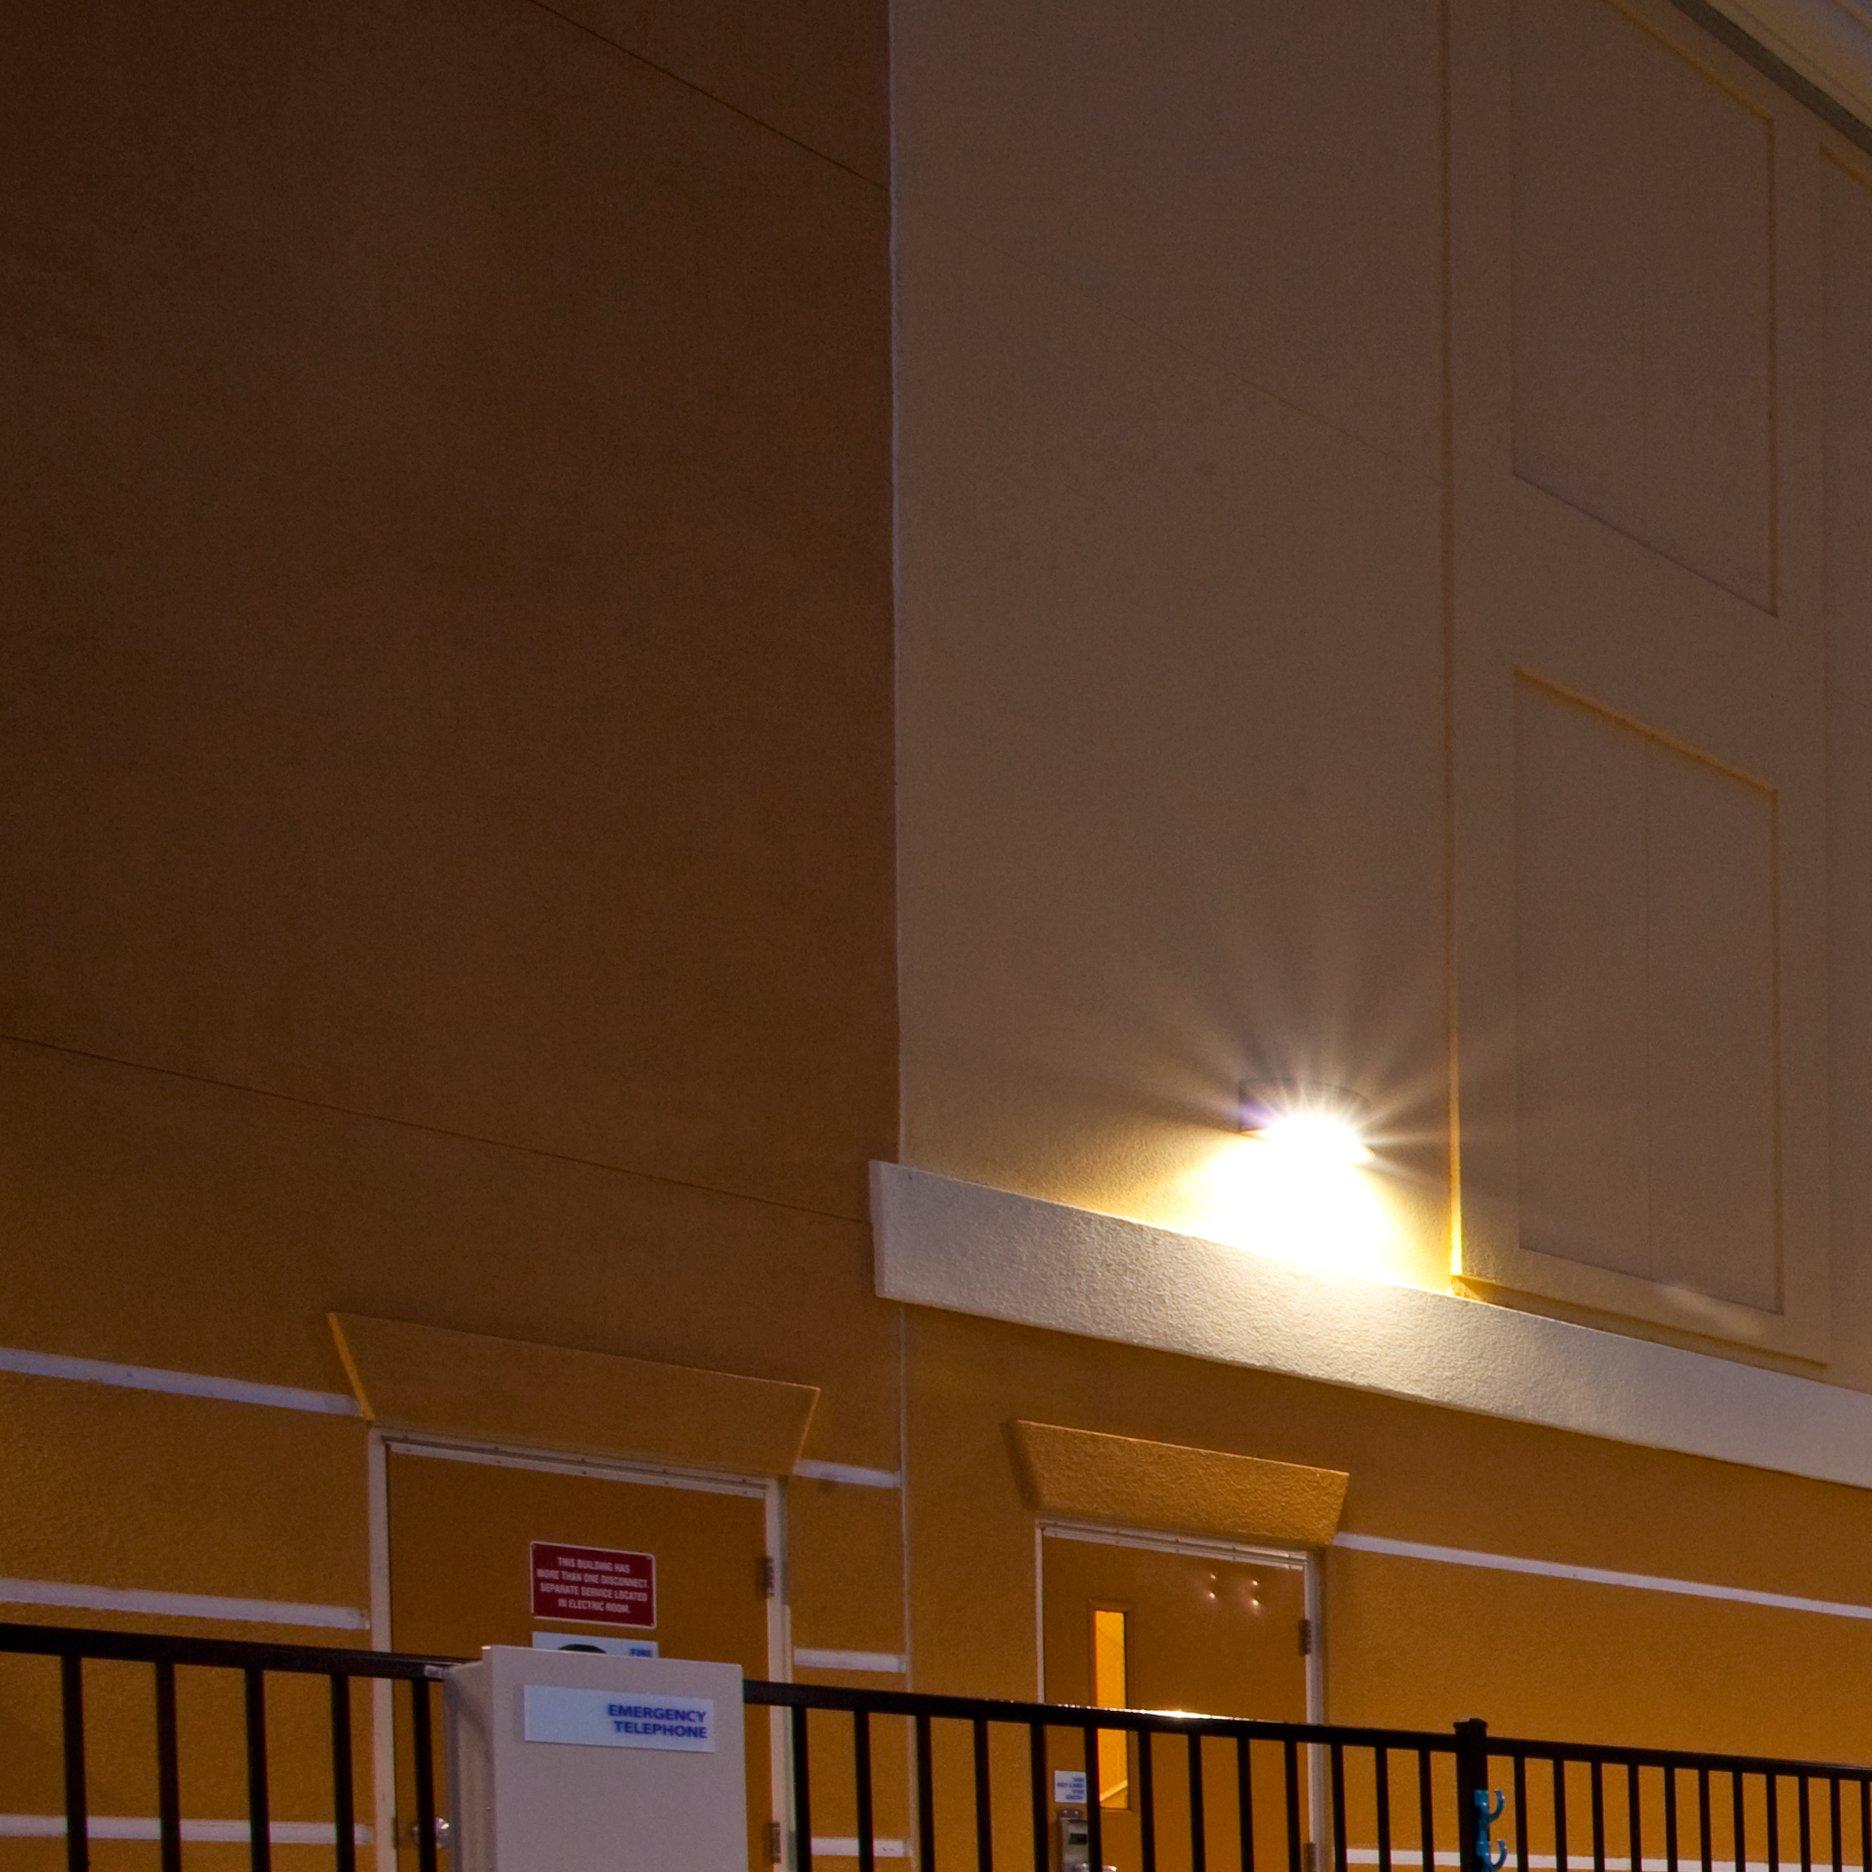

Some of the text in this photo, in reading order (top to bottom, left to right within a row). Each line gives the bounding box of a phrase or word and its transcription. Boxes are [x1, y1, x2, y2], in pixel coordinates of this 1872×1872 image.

[557, 1556, 630, 1574] THIS BUILDING HAS
[537, 1568, 560, 1580] MORE
[561, 1570, 582, 1582] THAN
[583, 1573, 599, 1584] ONE
[540, 1582, 648, 1602] SEPARATE SERVICE LOCATED
[558, 1598, 568, 1608] IN
[568, 1599, 605, 1612] ELECTRIC
[607, 1703, 707, 1723] EMERGENCY
[613, 1720, 708, 1739] TELEPHONE
